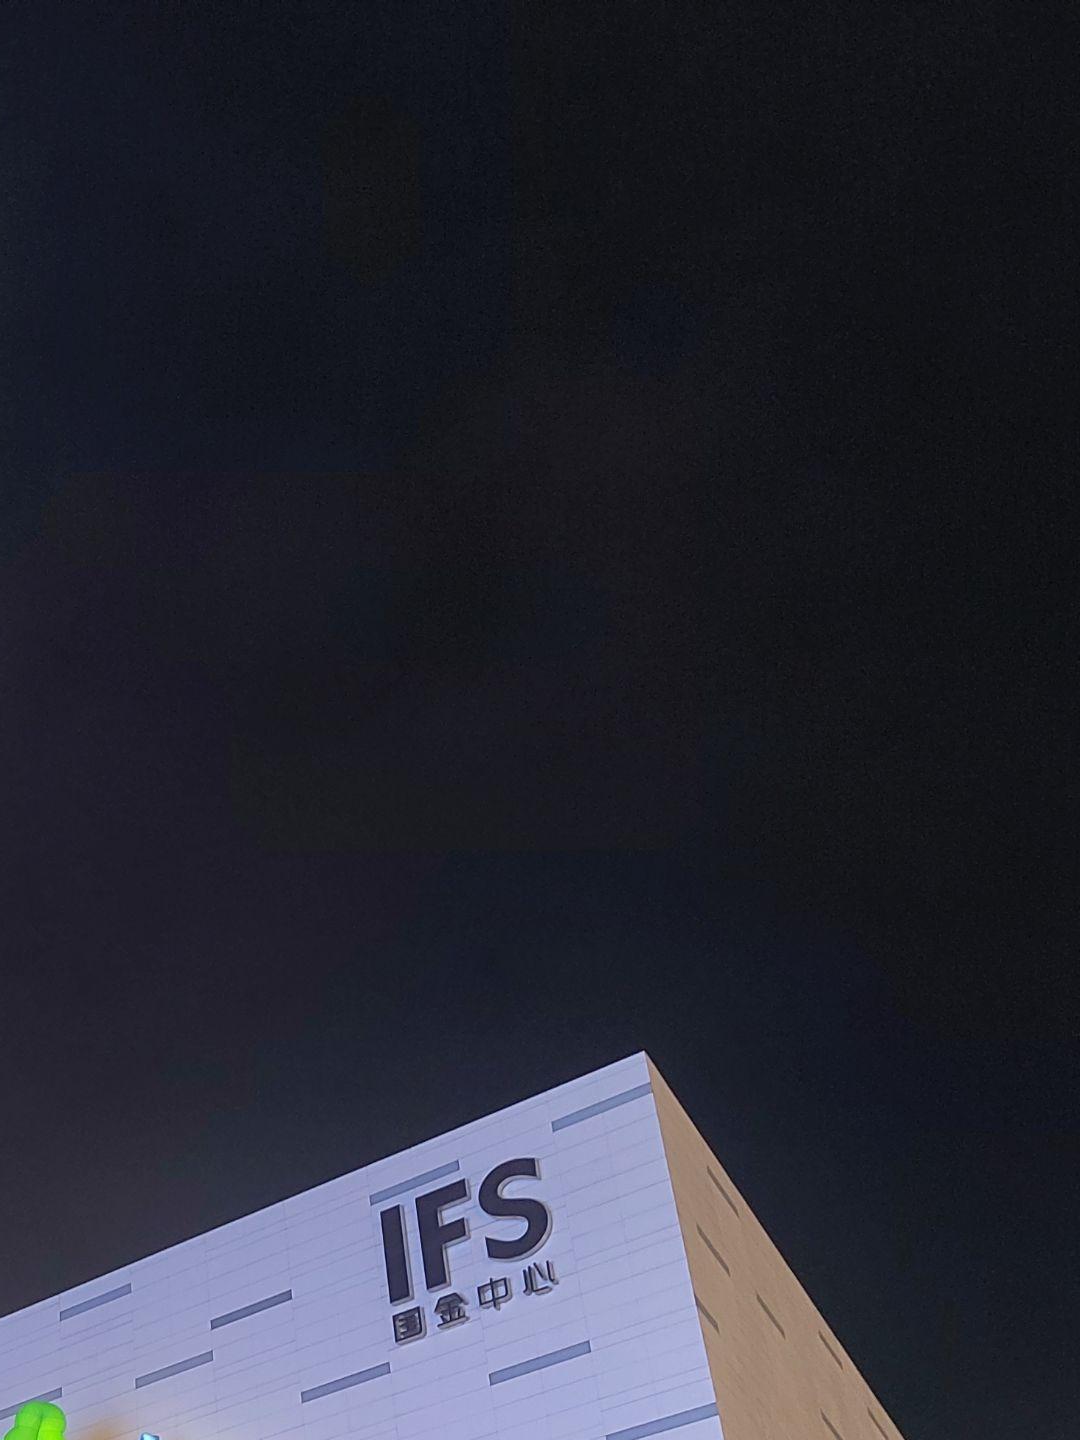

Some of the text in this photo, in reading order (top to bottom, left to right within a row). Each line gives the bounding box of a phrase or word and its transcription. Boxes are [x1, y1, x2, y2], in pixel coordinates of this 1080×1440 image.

[380, 1157, 552, 1305] IFS
[392, 1260, 559, 1344] 国金中心
